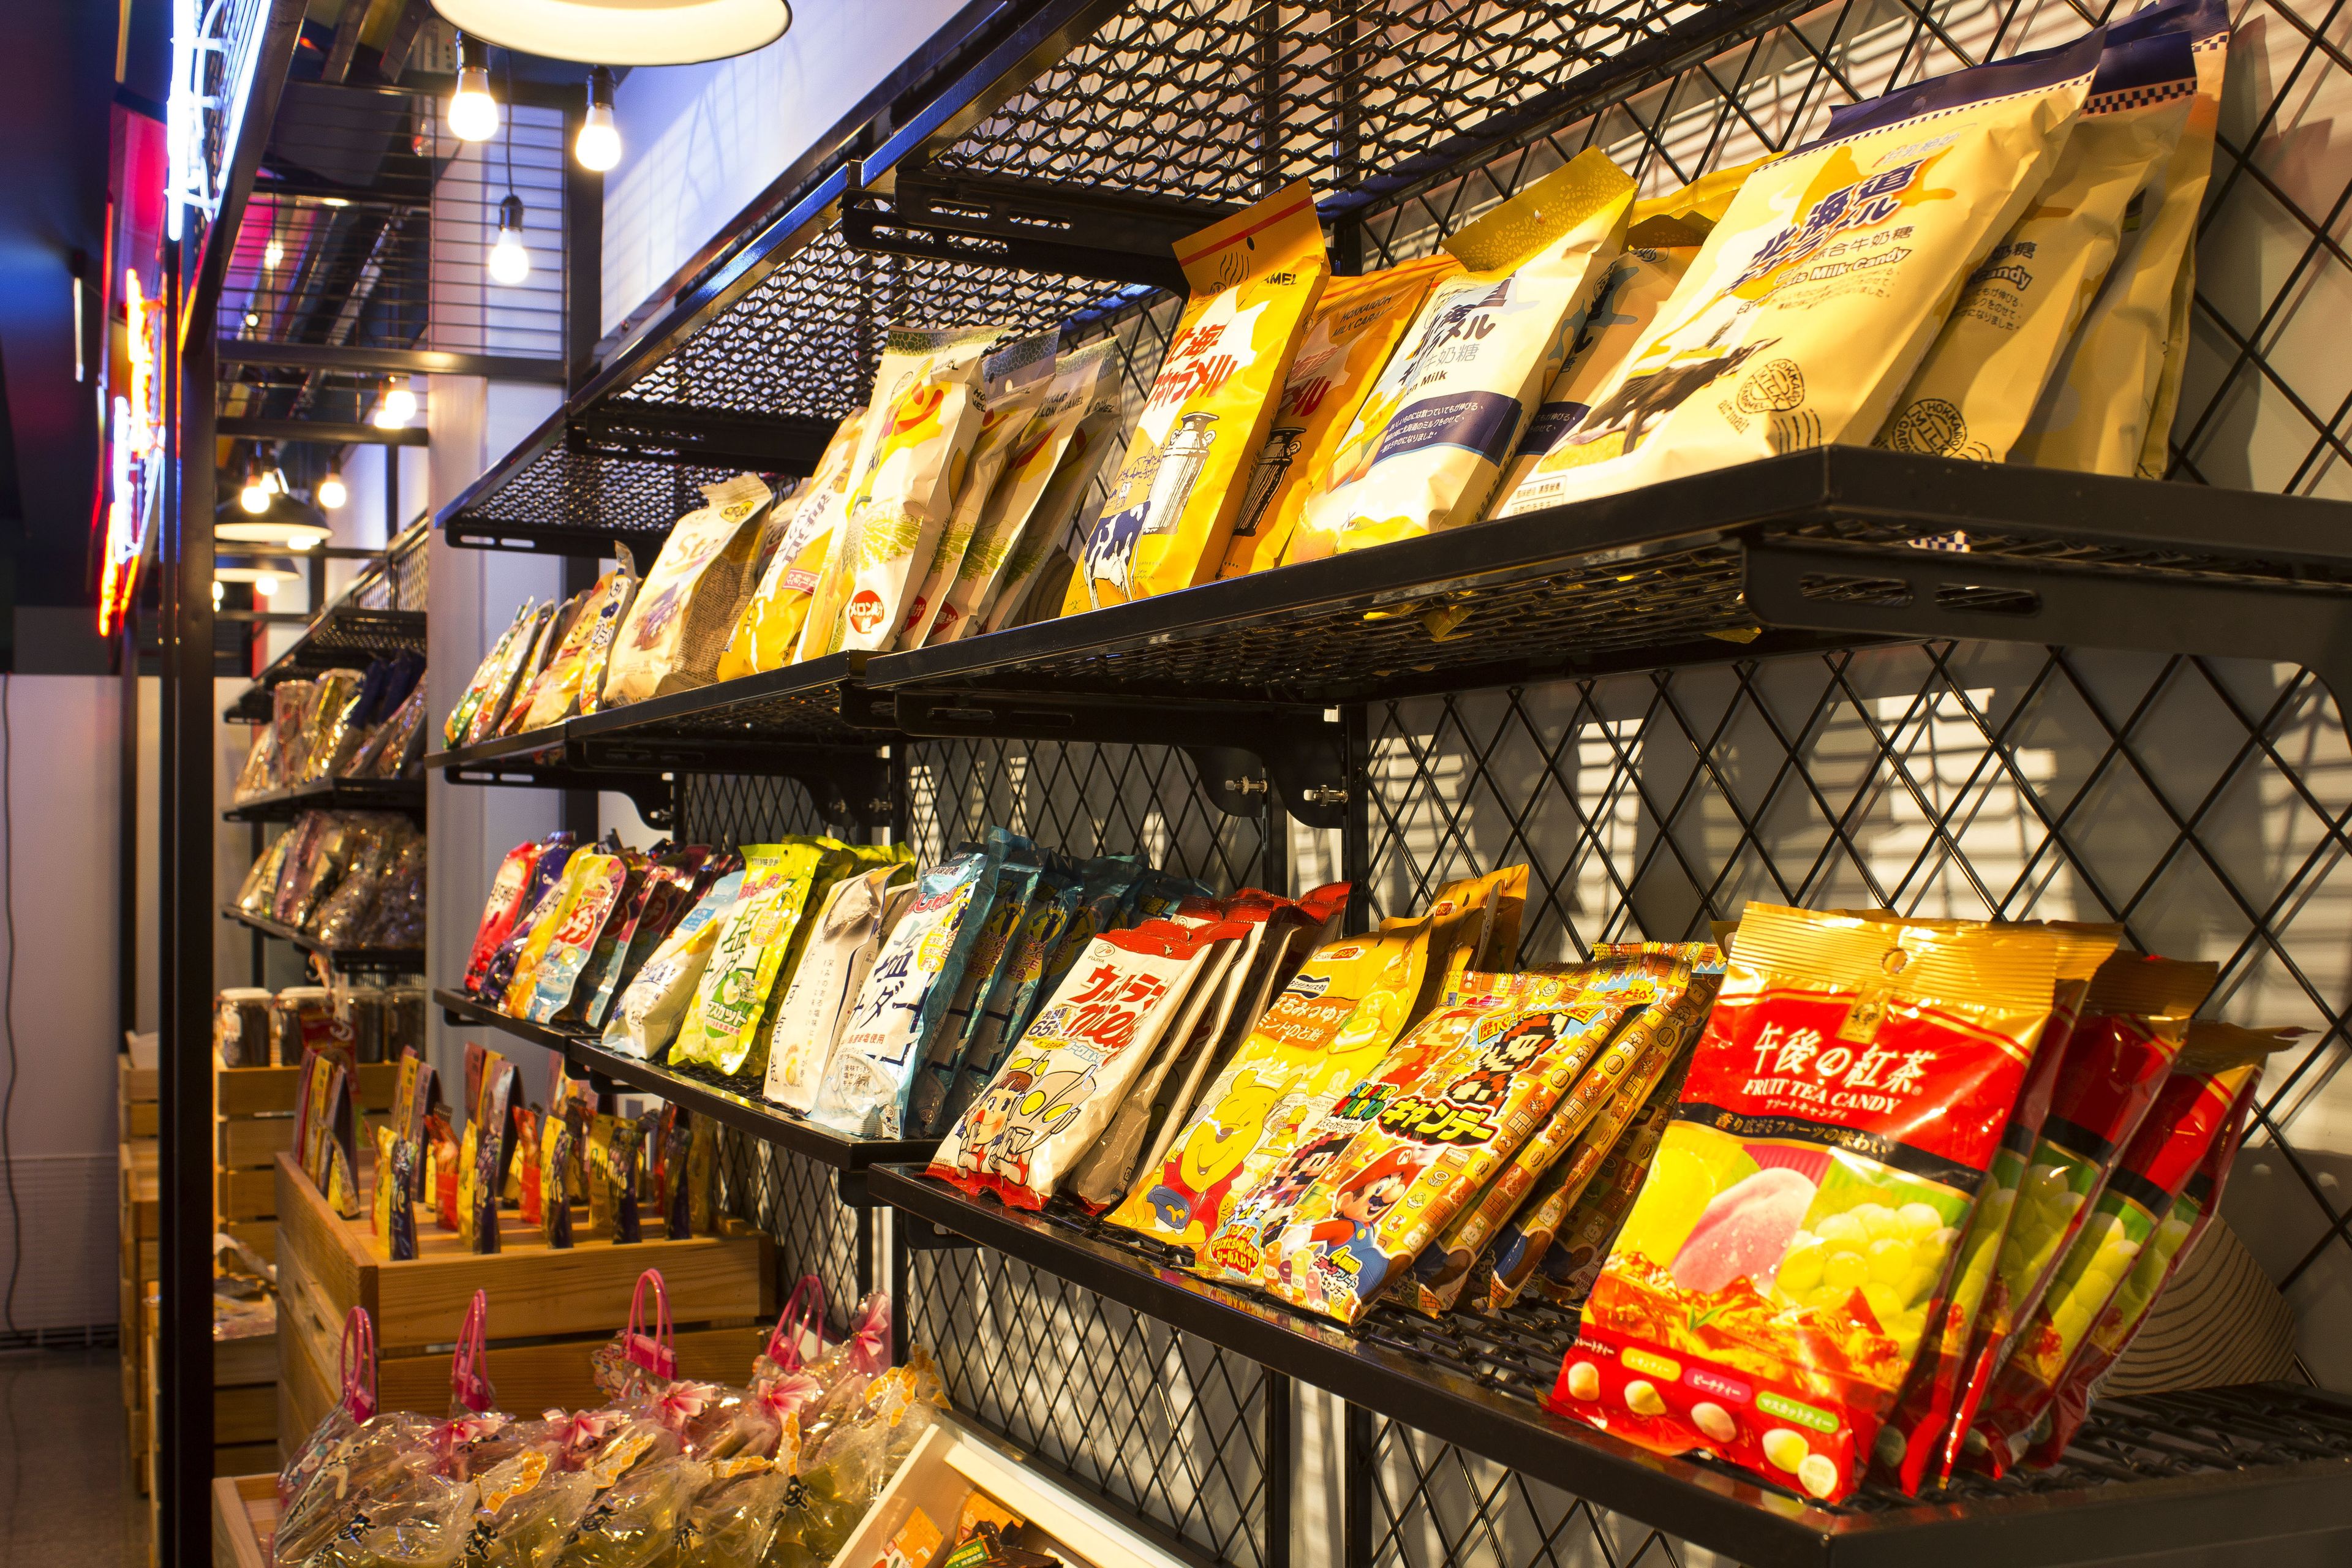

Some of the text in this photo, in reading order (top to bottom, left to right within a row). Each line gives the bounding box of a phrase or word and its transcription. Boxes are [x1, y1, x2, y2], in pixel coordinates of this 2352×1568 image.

[1749, 158, 1928, 267] 北海道
[1263, 272, 1297, 285] AMEL
[1809, 262, 1850, 282] Milk
[1852, 247, 1913, 271] Candy
[1421, 370, 1448, 386] Milk
[1757, 371, 1787, 404] MILK
[1910, 409, 1948, 456] MILK
[1272, 995, 1352, 1025] はちみつゆず
[1753, 1021, 1937, 1094] 午後の紅茶
[1349, 1082, 1398, 1101] SUPER
[1742, 1078, 1902, 1115] FRUIT TEA CANDY
[1334, 1096, 1385, 1121] MARIO
[1381, 1098, 1496, 1141] キャンデー
[1715, 1112, 1887, 1155] 香り広がるフルーツの味わい
[1692, 1373, 1743, 1398] ピーチティー
[1761, 1398, 1835, 1428] マスカットティー
